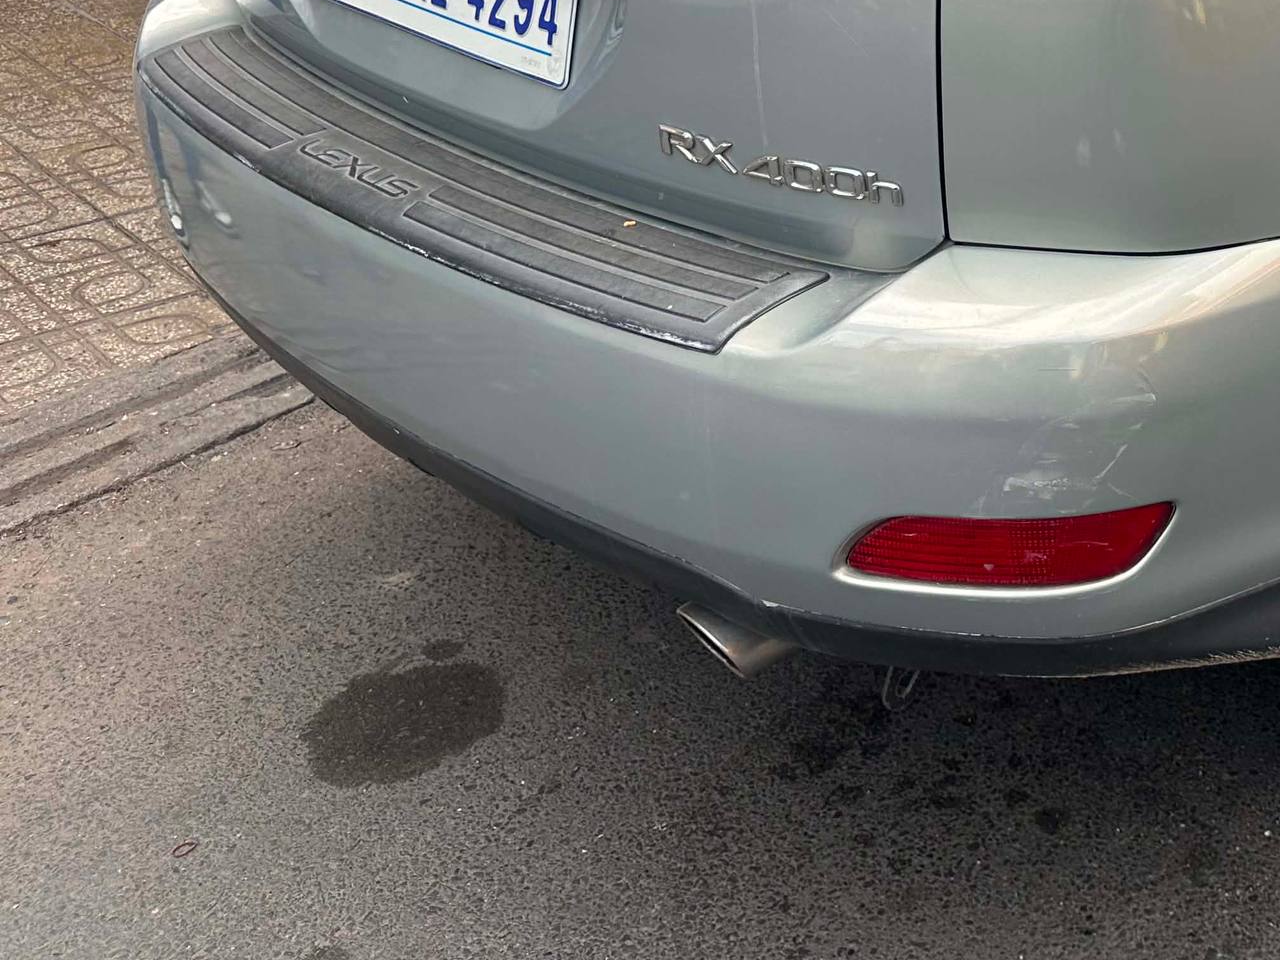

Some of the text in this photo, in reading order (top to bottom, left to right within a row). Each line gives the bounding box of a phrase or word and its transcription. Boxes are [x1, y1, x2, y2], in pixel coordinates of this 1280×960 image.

[299, 139, 420, 199] LEXUS
[658, 123, 905, 207] RX 400h
